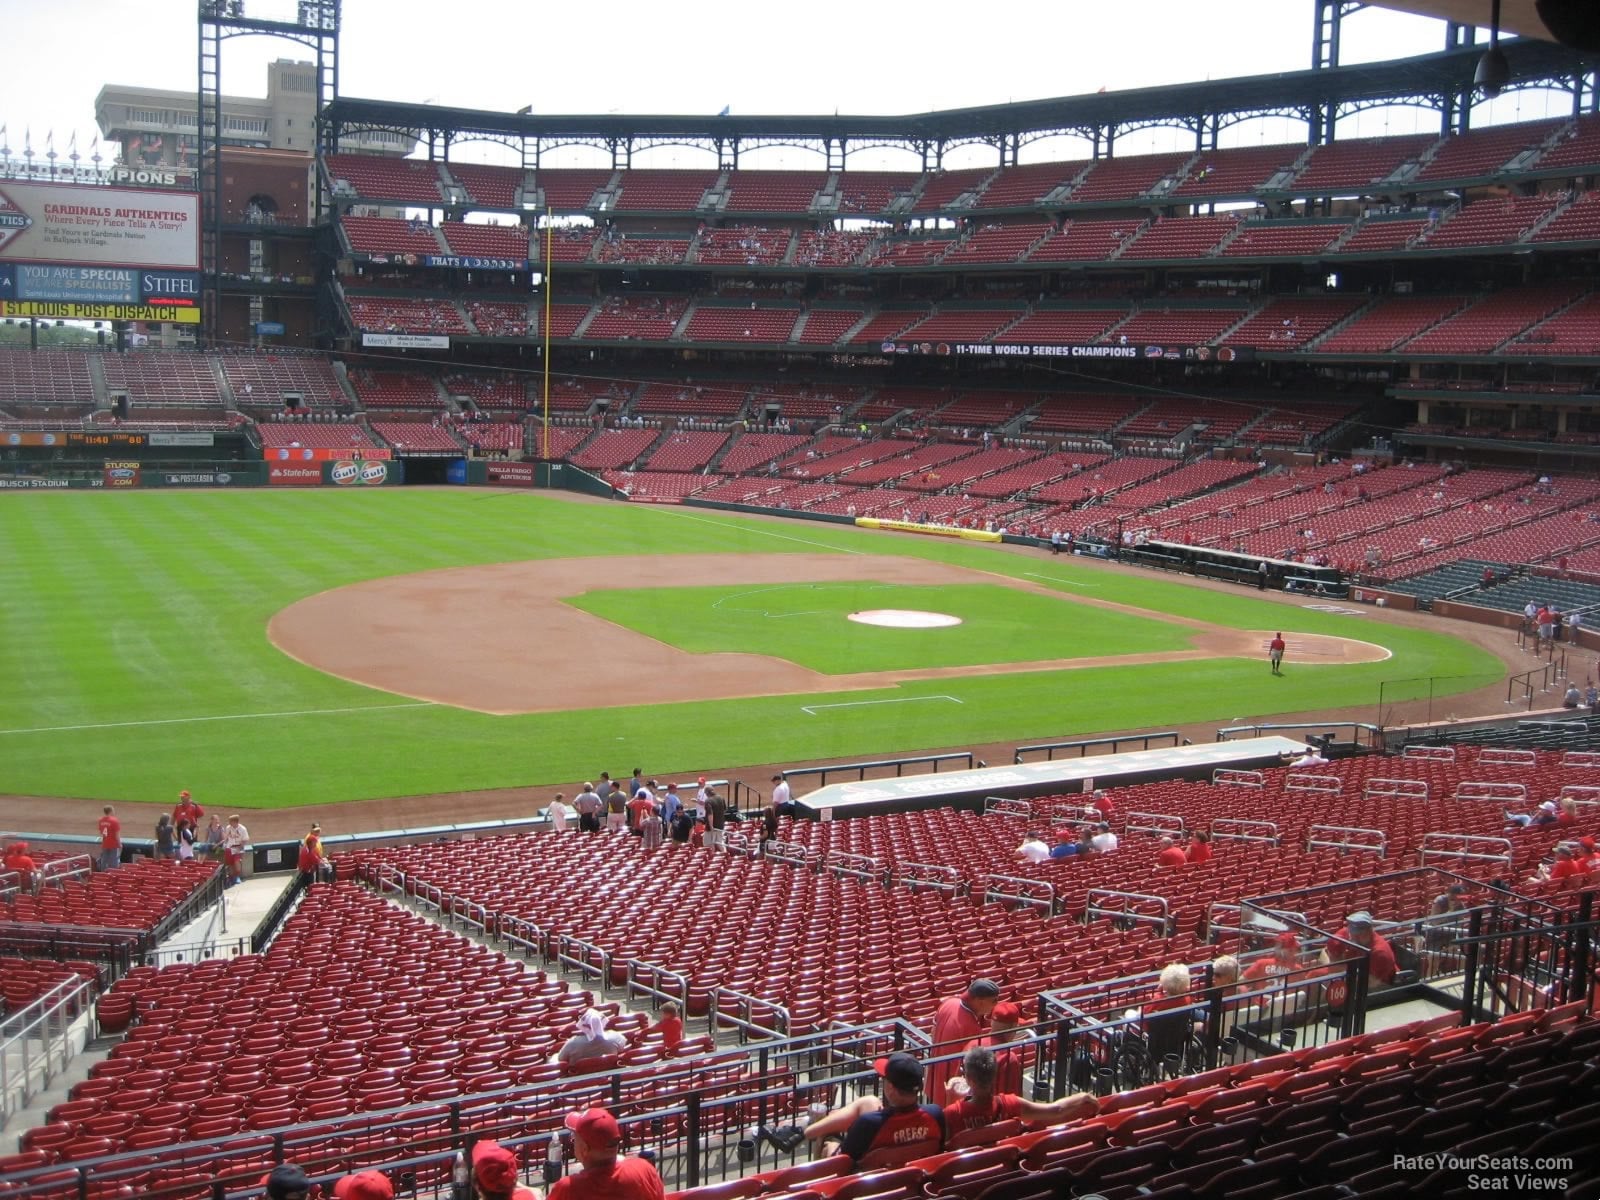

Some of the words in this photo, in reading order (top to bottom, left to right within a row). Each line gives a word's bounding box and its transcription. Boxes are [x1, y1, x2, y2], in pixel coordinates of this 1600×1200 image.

[57, 164, 176, 185] CHAMPIONS
[44, 204, 112, 217] CARDINALS
[115, 208, 187, 221] AUTHENTICS
[44, 214, 74, 224] Where
[76, 216, 101, 227] Every
[104, 218, 125, 227] Piece
[128, 219, 147, 228] Tells
[61, 228, 81, 236] Yours
[91, 230, 123, 238] Cardinals
[53, 236, 81, 245] Ballpark
[431, 257, 460, 266] THAT'S
[464, 258, 470, 267] A
[24, 267, 49, 278] YOU
[54, 268, 76, 279] ARE
[81, 269, 131, 281] SPECIAL
[25, 279, 41, 287] WE
[47, 279, 63, 288] ARE
[65, 279, 131, 290] SPECIALISTS
[43, 290, 61, 298] Louis
[63, 291, 95, 300] University
[96, 292, 123, 301] Hospital
[7, 302, 26, 315] ST.
[30, 302, 69, 316] LOUIS
[74, 304, 176, 320] POST-DISPATCH
[367, 337, 388, 346] Mercy
[956, 345, 993, 354] 11-TIME
[995, 345, 1031, 355] WORLD
[1033, 346, 1069, 356] SERIES
[1072, 346, 1137, 357] CHAMPIONS
[85, 436, 109, 444] 11:40
[333, 467, 358, 479] Gulf
[361, 467, 385, 479] Gulf
[180, 475, 213, 483] POSTSEASON
[1330, 987, 1345, 1000] 160
